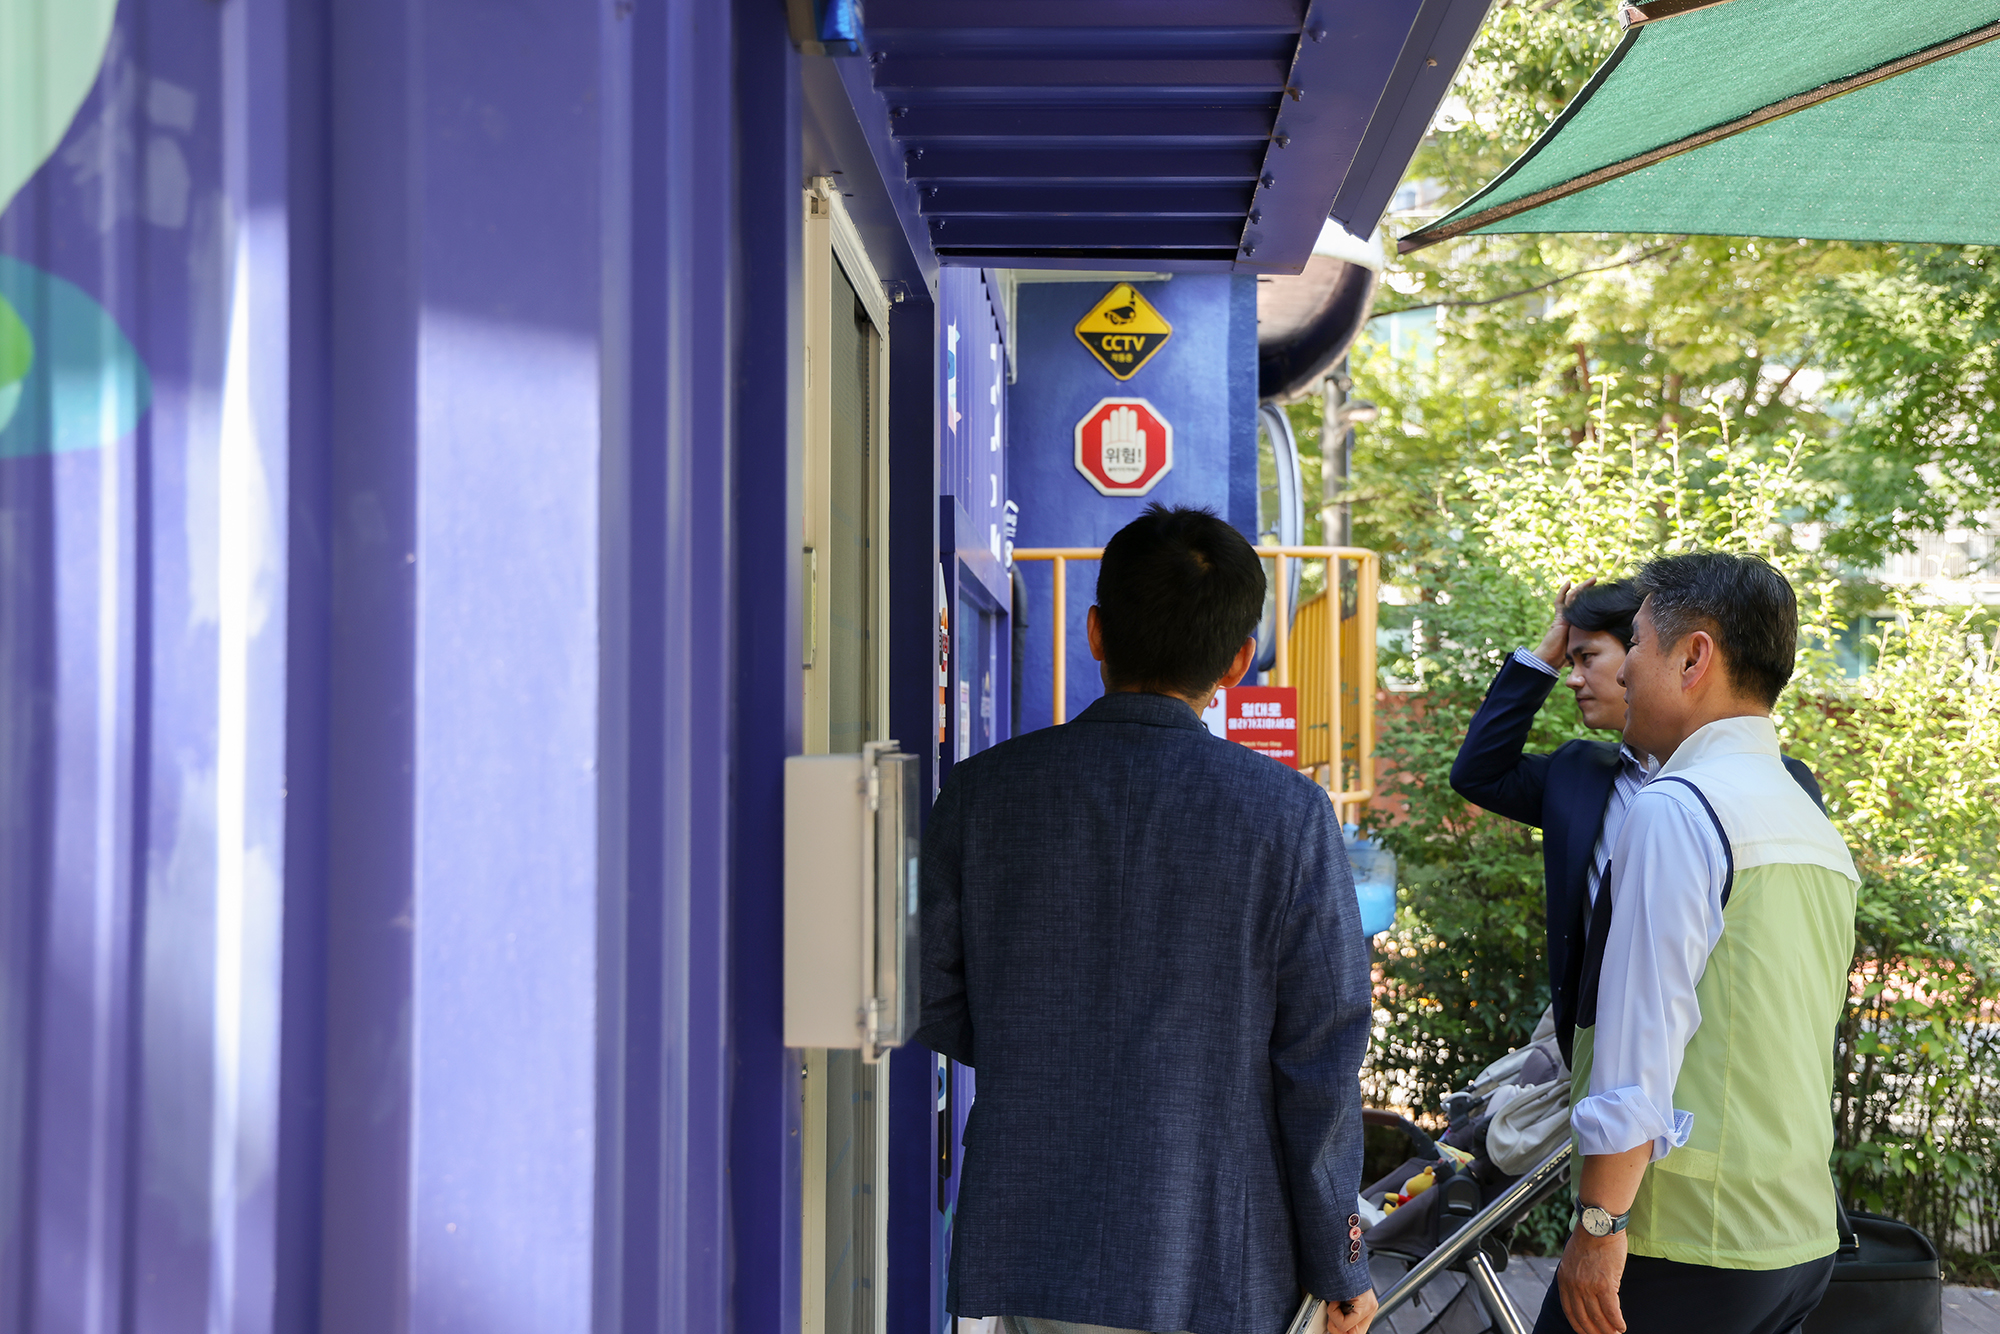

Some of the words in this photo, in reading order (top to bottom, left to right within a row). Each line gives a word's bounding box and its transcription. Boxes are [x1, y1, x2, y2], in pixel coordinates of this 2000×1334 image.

[1101, 335, 1146, 351] CCTV
[1104, 447, 1141, 464] 위험!
[1241, 702, 1282, 717] 절대로
